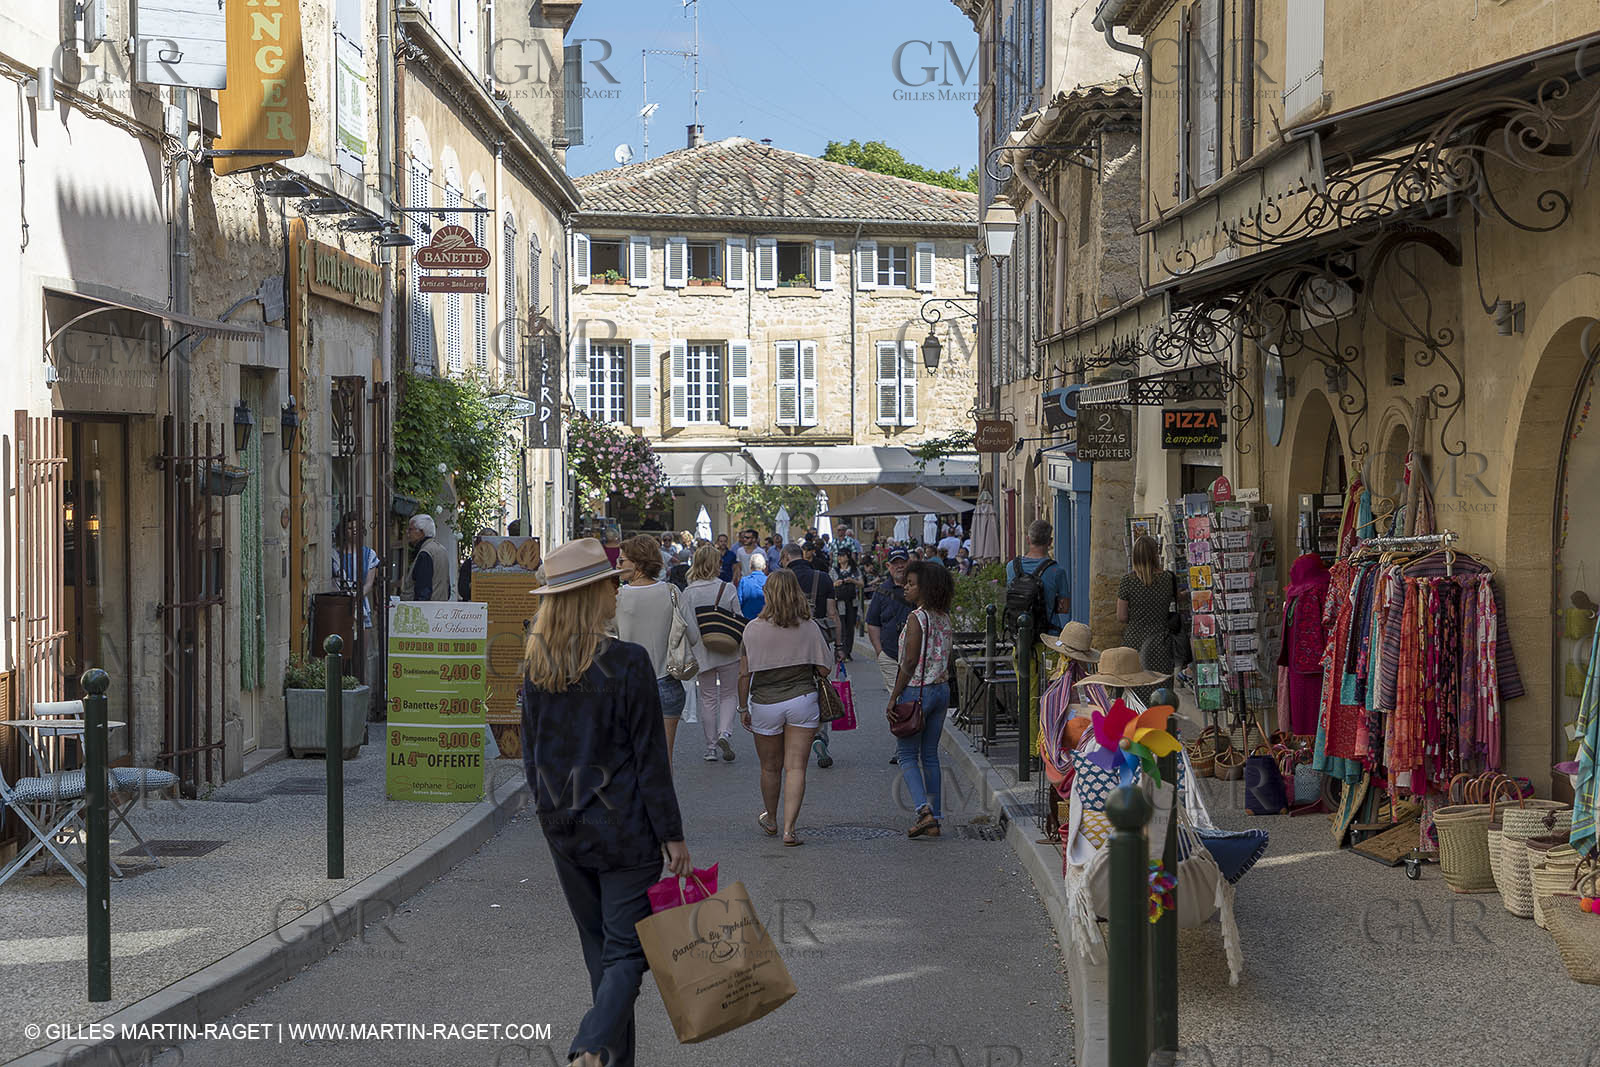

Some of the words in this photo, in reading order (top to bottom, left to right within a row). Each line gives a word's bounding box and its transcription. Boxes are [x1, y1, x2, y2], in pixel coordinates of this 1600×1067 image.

[247, 0, 296, 141] NGER
[424, 253, 483, 263] BANETTE
[451, 280, 484, 290] Boulanger
[1097, 413, 1114, 432] 2
[1164, 412, 1218, 428] PIZZA
[1088, 434, 1126, 443] PIZZAS
[1173, 435, 1219, 447] emporter
[1079, 449, 1131, 458] EMPORTER
[434, 608, 448, 620] La
[450, 608, 482, 620] Maison
[432, 623, 443, 633] du
[445, 623, 485, 633] Gibassier
[392, 663, 402, 678] 3
[392, 697, 401, 712] 3
[403, 700, 438, 710] Banettes
[391, 731, 401, 746] 3
[391, 753, 405, 766] LA
[428, 754, 480, 768] OFFERTE
